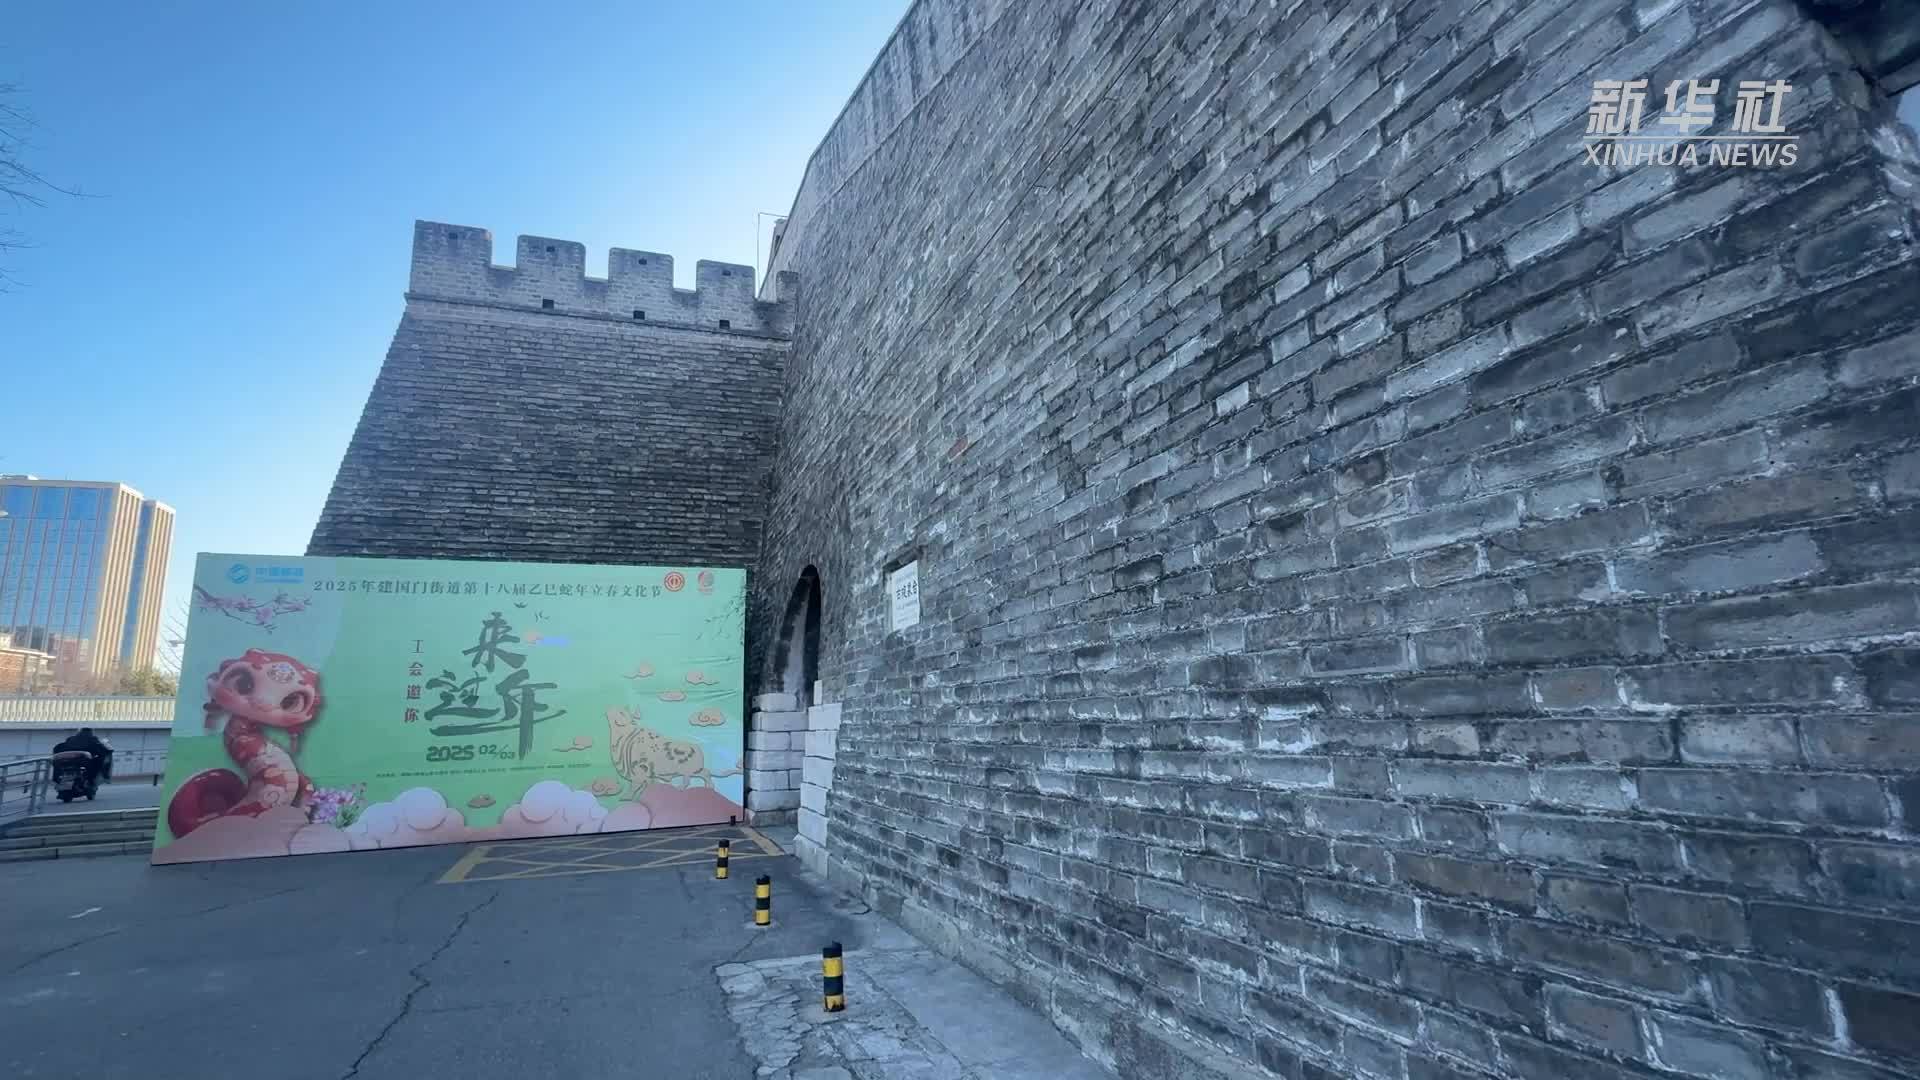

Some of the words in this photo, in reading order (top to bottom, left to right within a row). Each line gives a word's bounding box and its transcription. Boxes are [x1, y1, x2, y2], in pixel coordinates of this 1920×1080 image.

[313, 579, 663, 598] 2025年建国门街道第十八届乙巳蛇年立春文化节
[404, 639, 424, 723] 工会邀你
[426, 744, 475, 762] 2025
